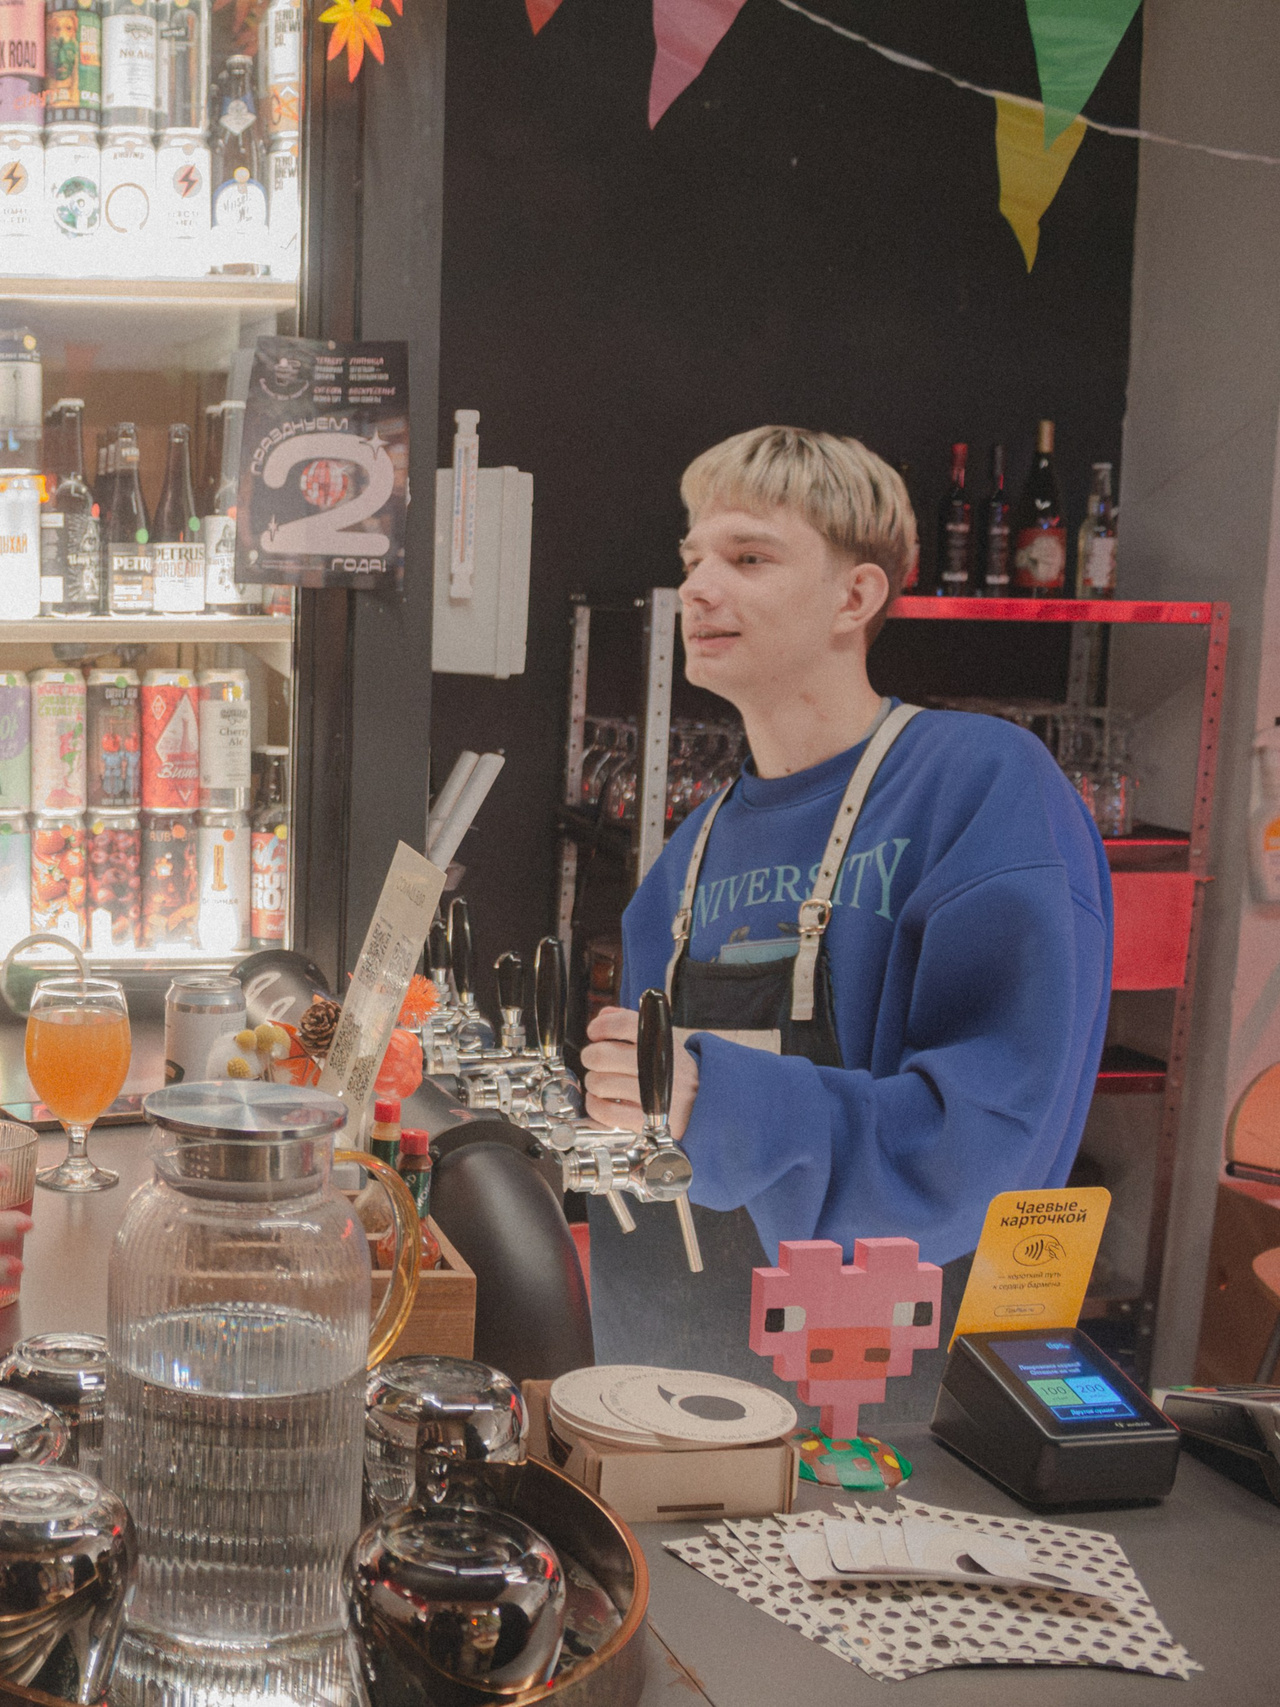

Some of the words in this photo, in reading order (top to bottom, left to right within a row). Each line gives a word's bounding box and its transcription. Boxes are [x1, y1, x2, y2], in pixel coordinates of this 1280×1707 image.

[8, 39, 38, 70] ROAD
[250, 417, 349, 475] ПРАЗДНУЕМ
[260, 432, 395, 557] 2
[113, 555, 153, 573] PETR
[331, 557, 387, 574] ГОДА!
[1016, 1201, 1078, 1214] Чаевые
[1000, 1209, 1087, 1229] карточкой
[1039, 1386, 1067, 1396] 100
[1076, 1383, 1105, 1394] 200
